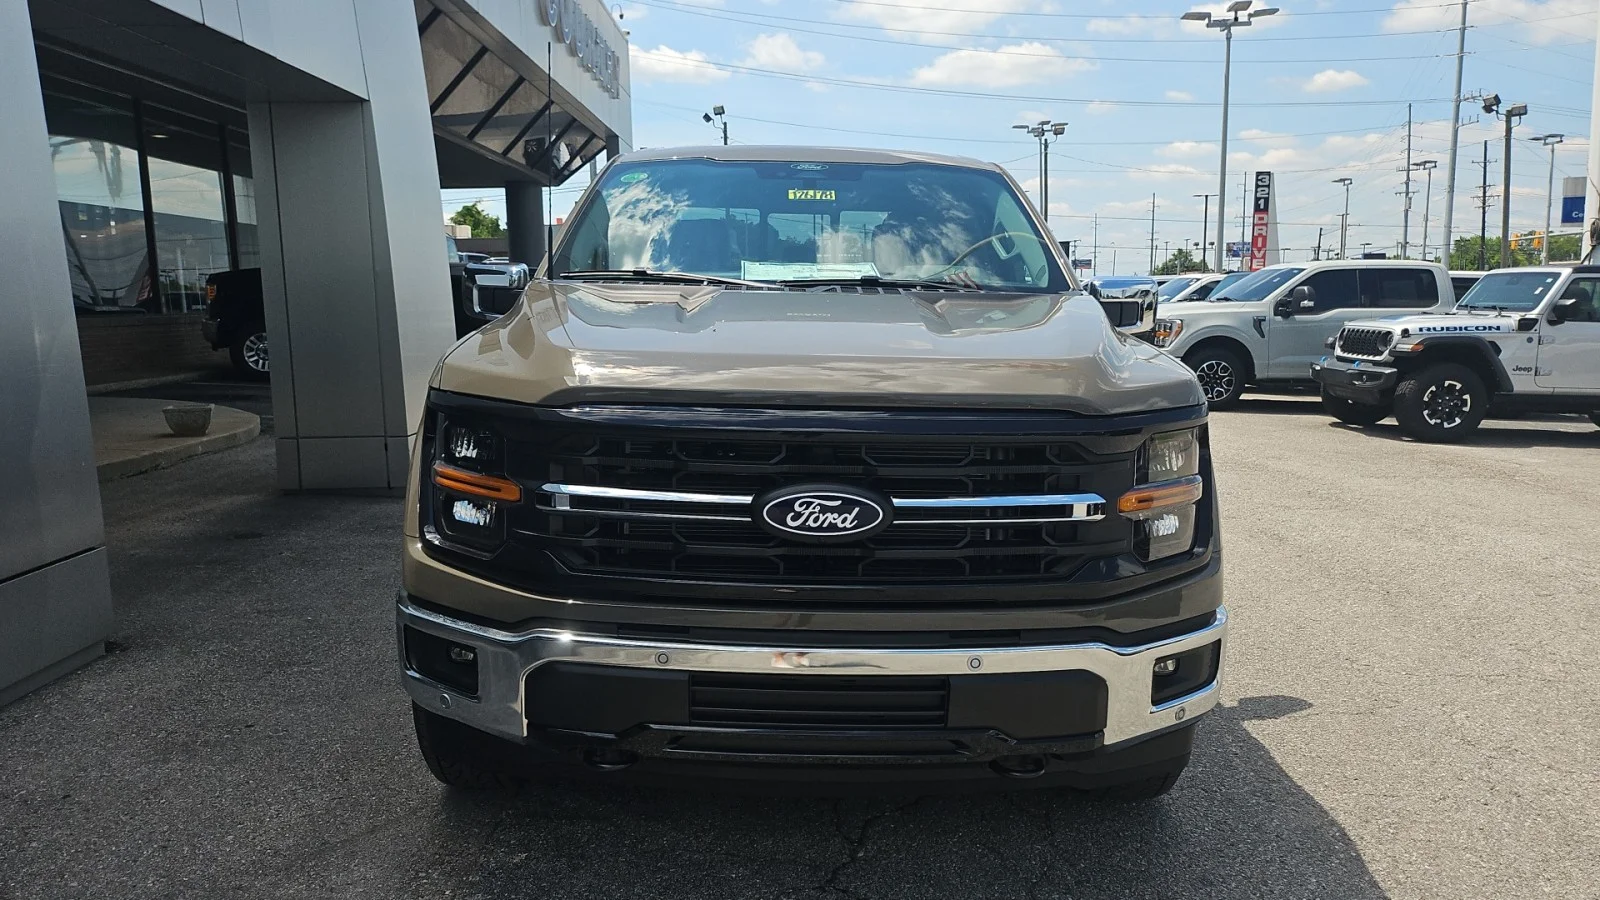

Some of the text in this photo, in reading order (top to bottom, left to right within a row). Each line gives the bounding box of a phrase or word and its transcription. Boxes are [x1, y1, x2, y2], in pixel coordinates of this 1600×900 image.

[1252, 174, 1270, 269] 321 DRIVE
[1512, 364, 1533, 373] Jeep
[786, 498, 860, 528] Ford
